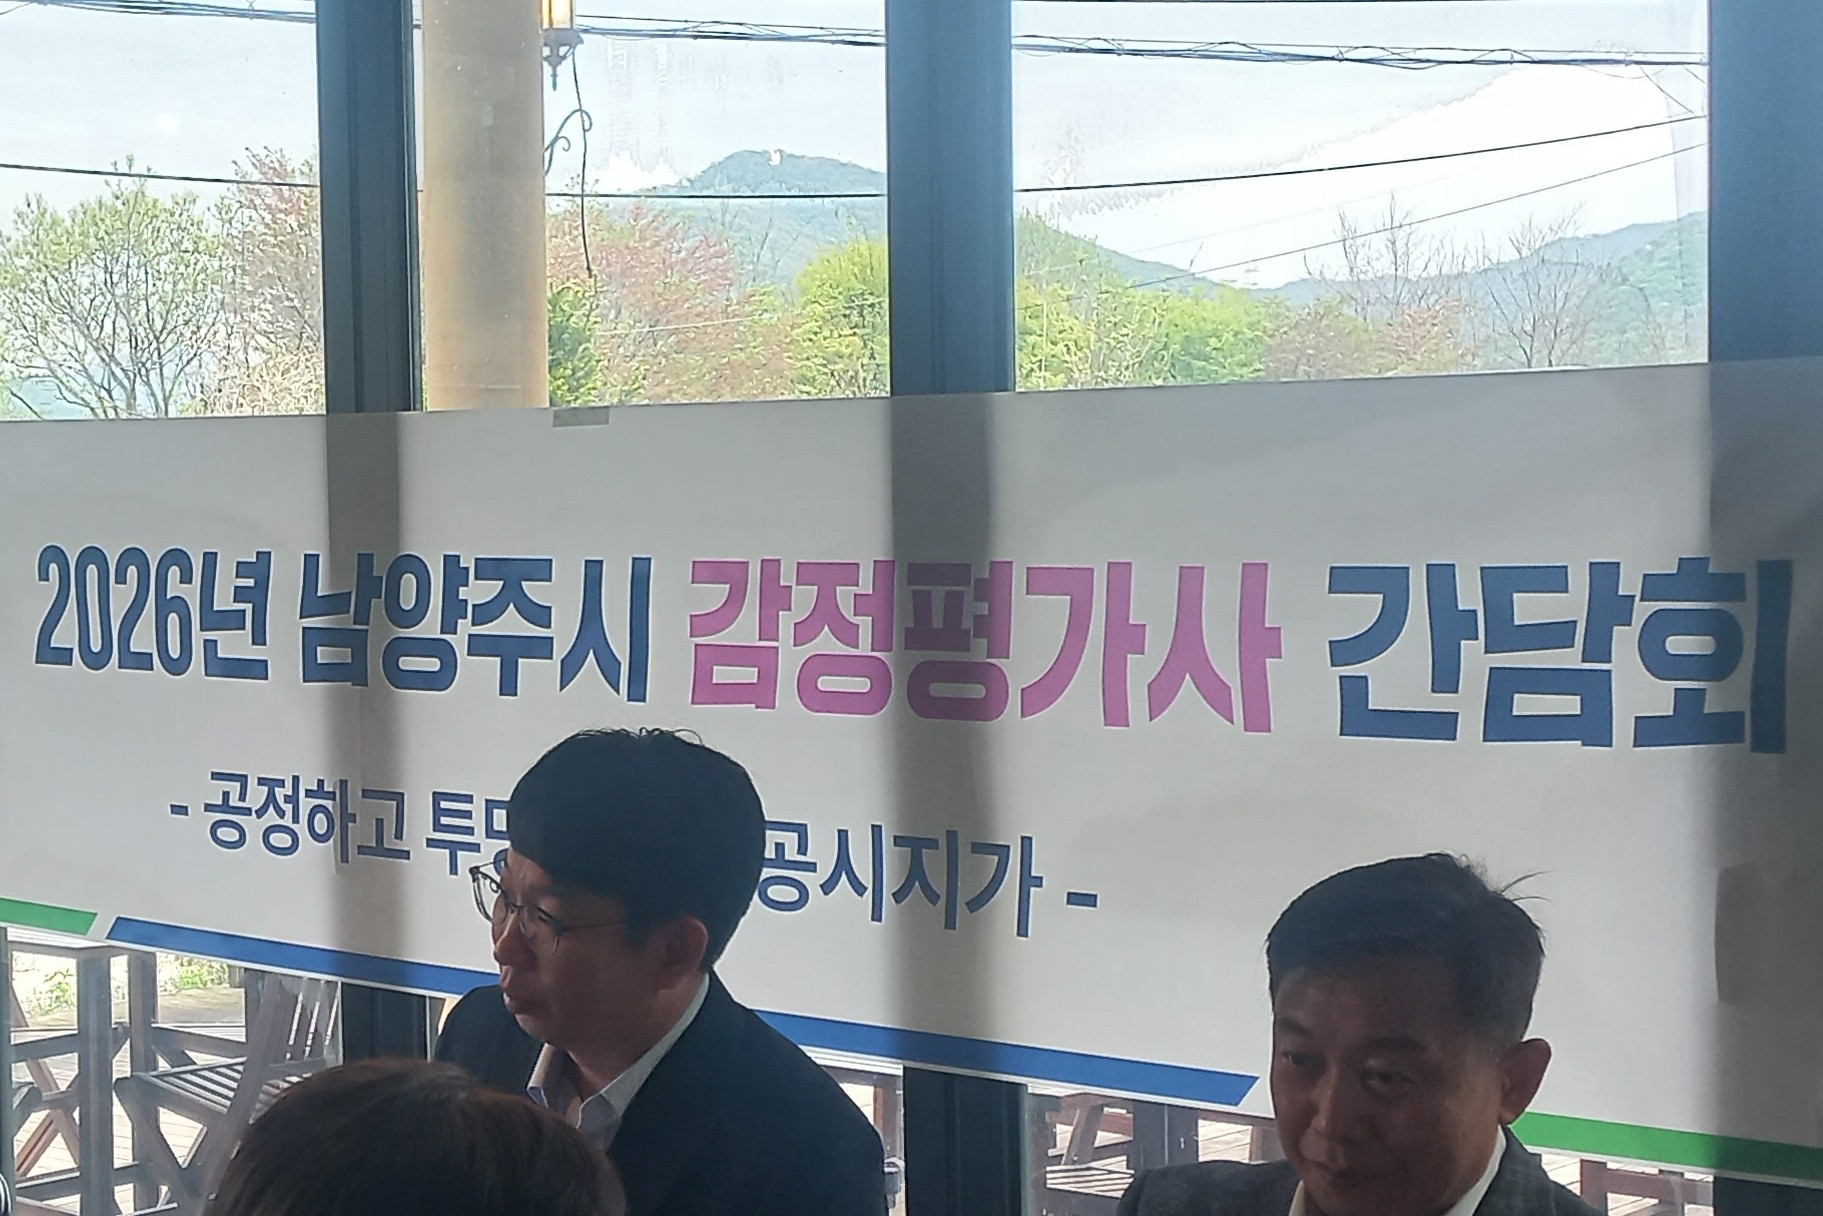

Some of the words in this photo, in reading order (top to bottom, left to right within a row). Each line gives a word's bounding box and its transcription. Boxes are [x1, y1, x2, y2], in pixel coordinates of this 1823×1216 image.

[34, 543, 273, 682] 2026년
[297, 551, 652, 704] 남양주시
[688, 557, 1282, 733] 감정평가사
[1327, 557, 1793, 754] 간담회
[203, 771, 410, 863] 공정하고
[757, 819, 1043, 938] 공시지가
